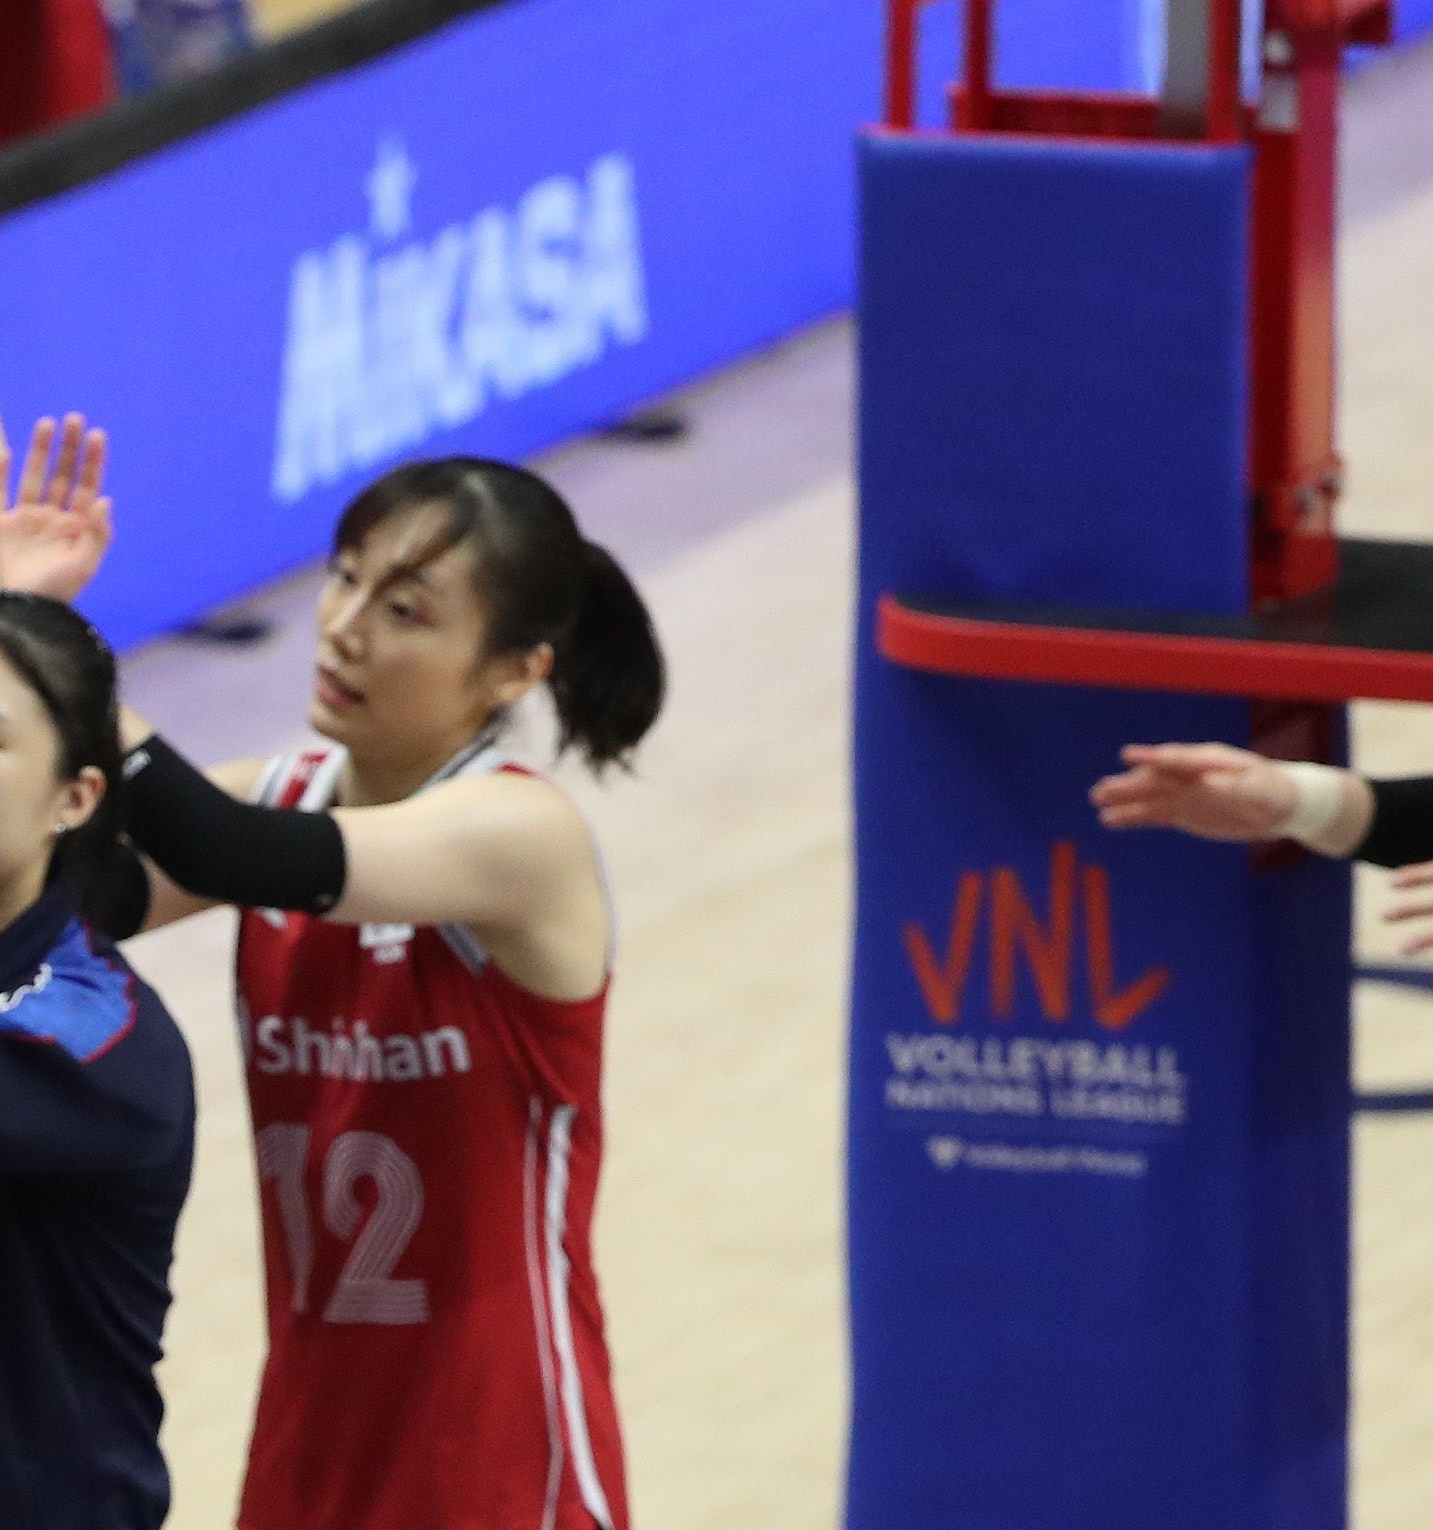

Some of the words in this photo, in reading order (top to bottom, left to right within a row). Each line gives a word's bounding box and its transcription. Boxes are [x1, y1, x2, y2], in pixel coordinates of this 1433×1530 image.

[902, 842, 1173, 1031] VNL
[256, 1014, 474, 1082] Shihan
[887, 1035, 1182, 1085] VOLLEYBALL
[254, 1122, 431, 1326] 12
